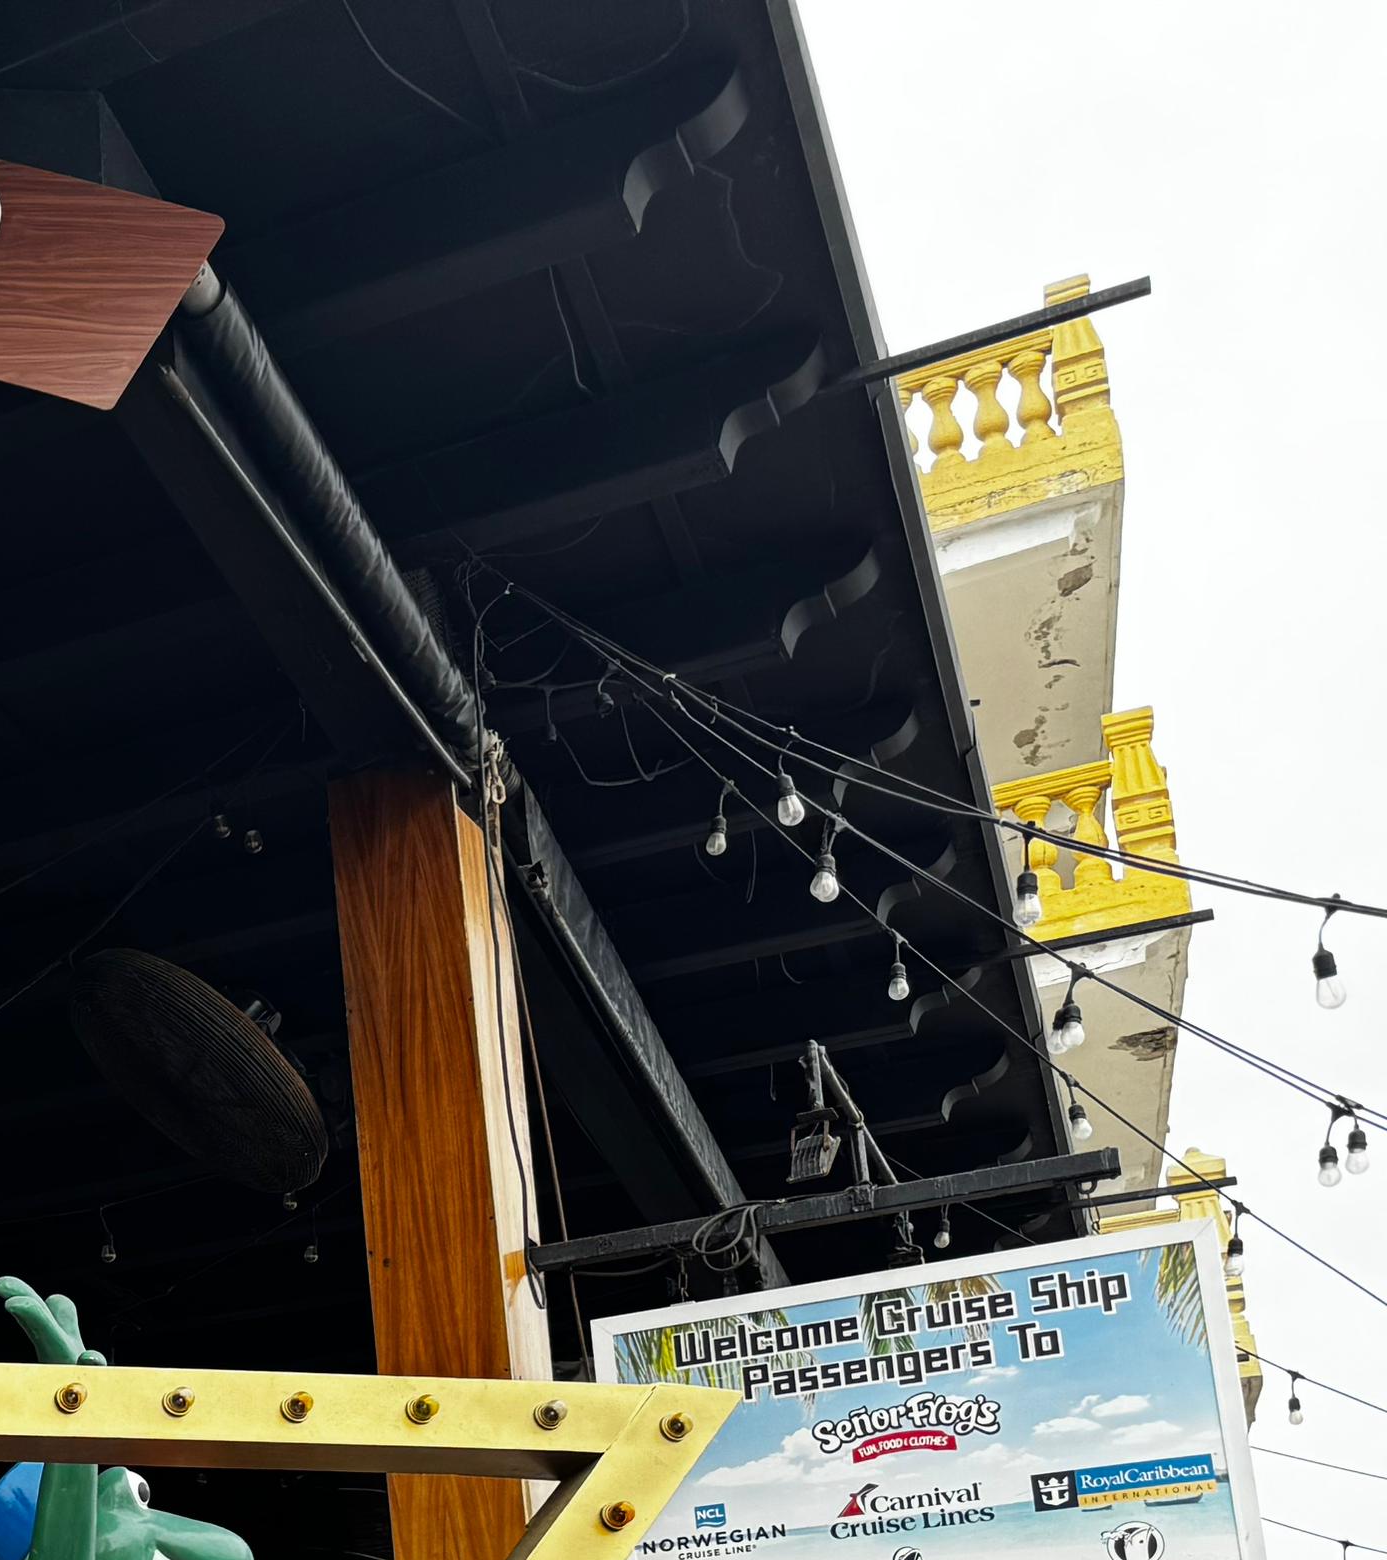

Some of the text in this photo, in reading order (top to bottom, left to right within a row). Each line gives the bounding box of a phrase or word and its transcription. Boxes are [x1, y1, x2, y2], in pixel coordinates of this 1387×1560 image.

[673, 1270, 1129, 1367] Welcome Cruise Ship
[742, 1322, 1063, 1400] Passengers To
[813, 1391, 1000, 1453] Señor Frog's
[909, 1435, 949, 1447] CLOTHES
[870, 1482, 981, 1513] Carnival
[1083, 1482, 1214, 1504] INTERNATIONAL
[695, 1508, 725, 1521] NCL
[830, 1505, 996, 1540] Cruise Lines
[642, 1523, 787, 1555] NORWEGIAN
[678, 1548, 721, 1560] CRUISE
